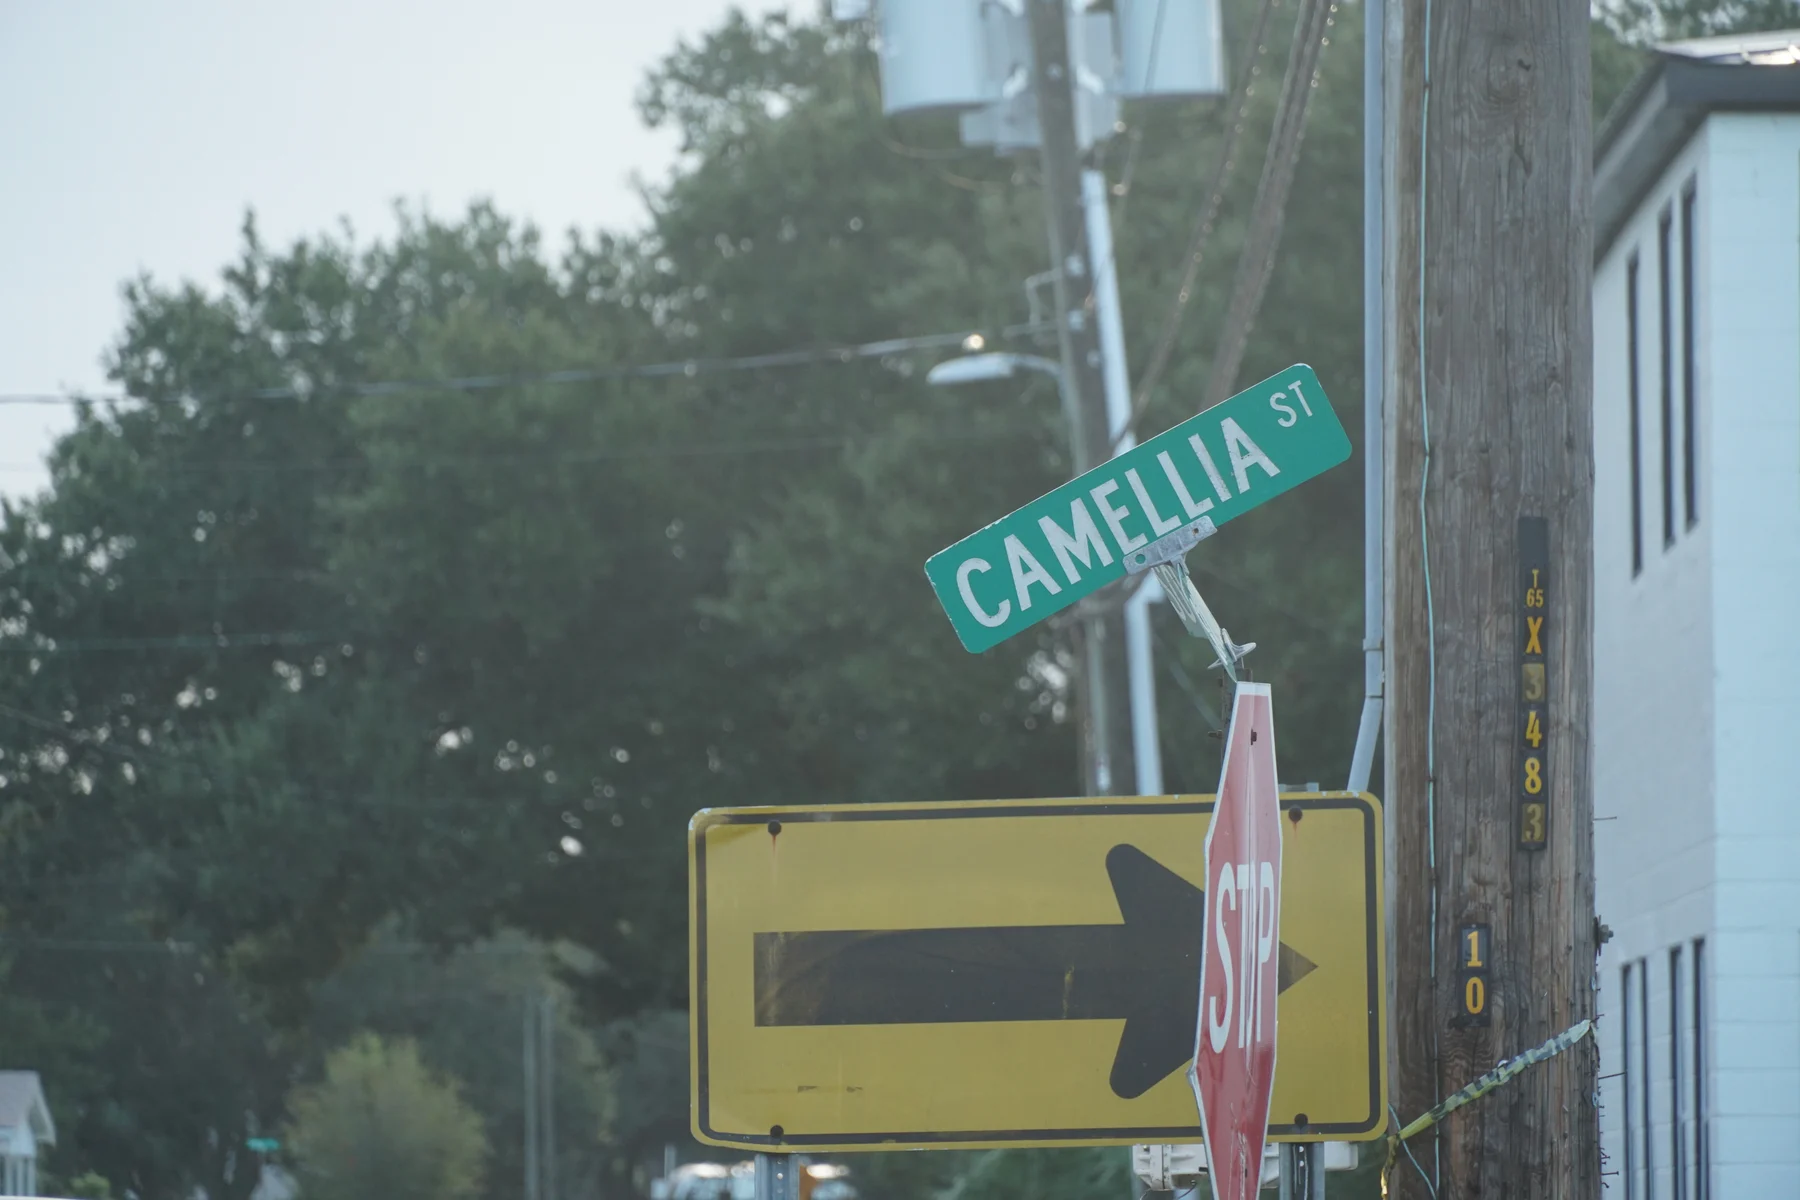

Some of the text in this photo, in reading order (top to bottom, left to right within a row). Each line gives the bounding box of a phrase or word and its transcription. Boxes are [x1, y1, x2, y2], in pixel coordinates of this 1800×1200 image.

[956, 416, 1281, 628] CAMELLIA
[1269, 380, 1313, 428] ST
[1526, 588, 1544, 608] 65
